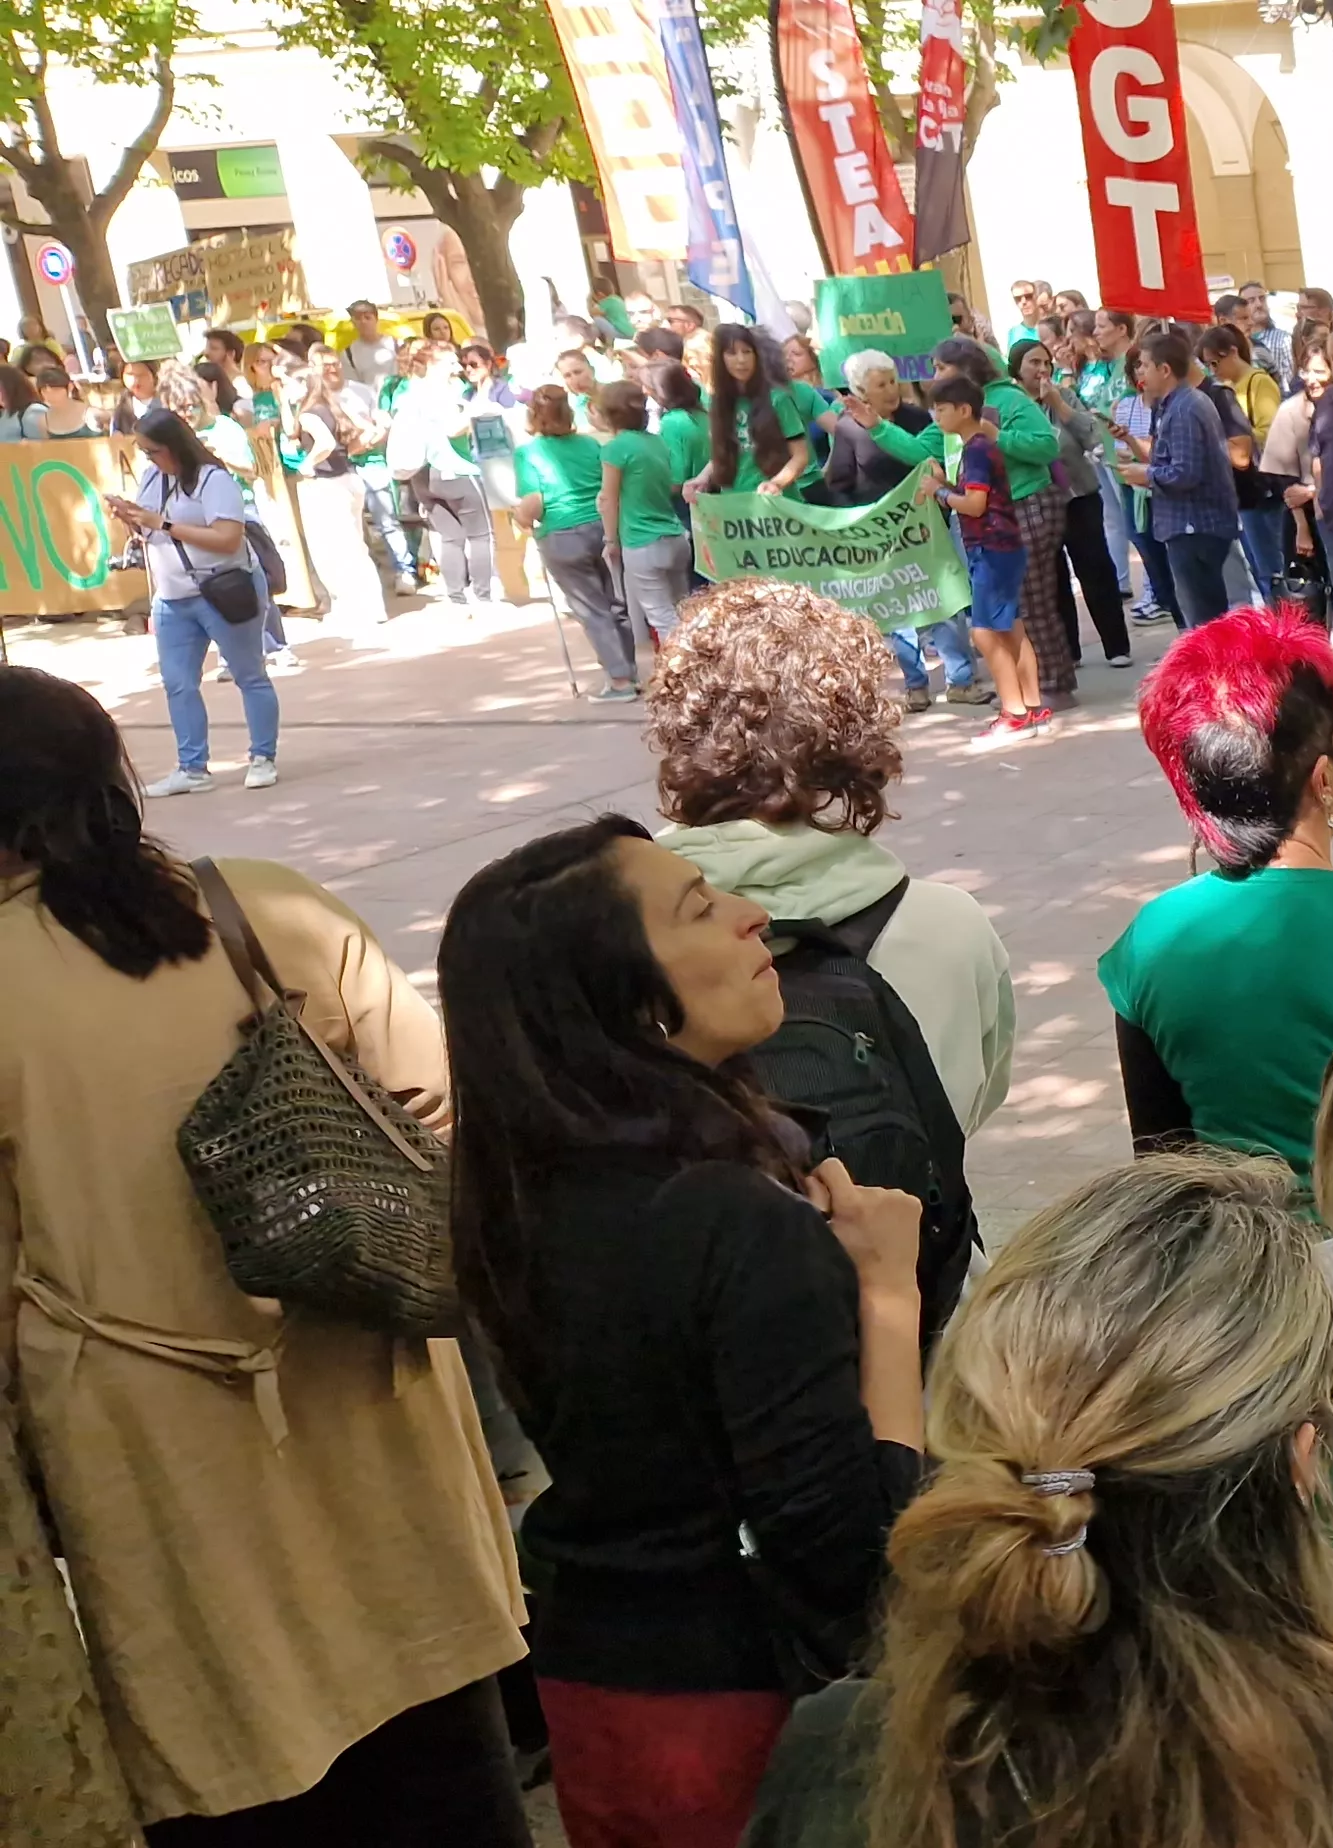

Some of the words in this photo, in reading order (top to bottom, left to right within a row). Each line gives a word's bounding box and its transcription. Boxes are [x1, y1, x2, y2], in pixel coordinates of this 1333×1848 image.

[1083, 0, 1181, 291] GT
[723, 513, 805, 541] DINERO
[735, 551, 761, 571] LA
[893, 562, 929, 586] DEL
